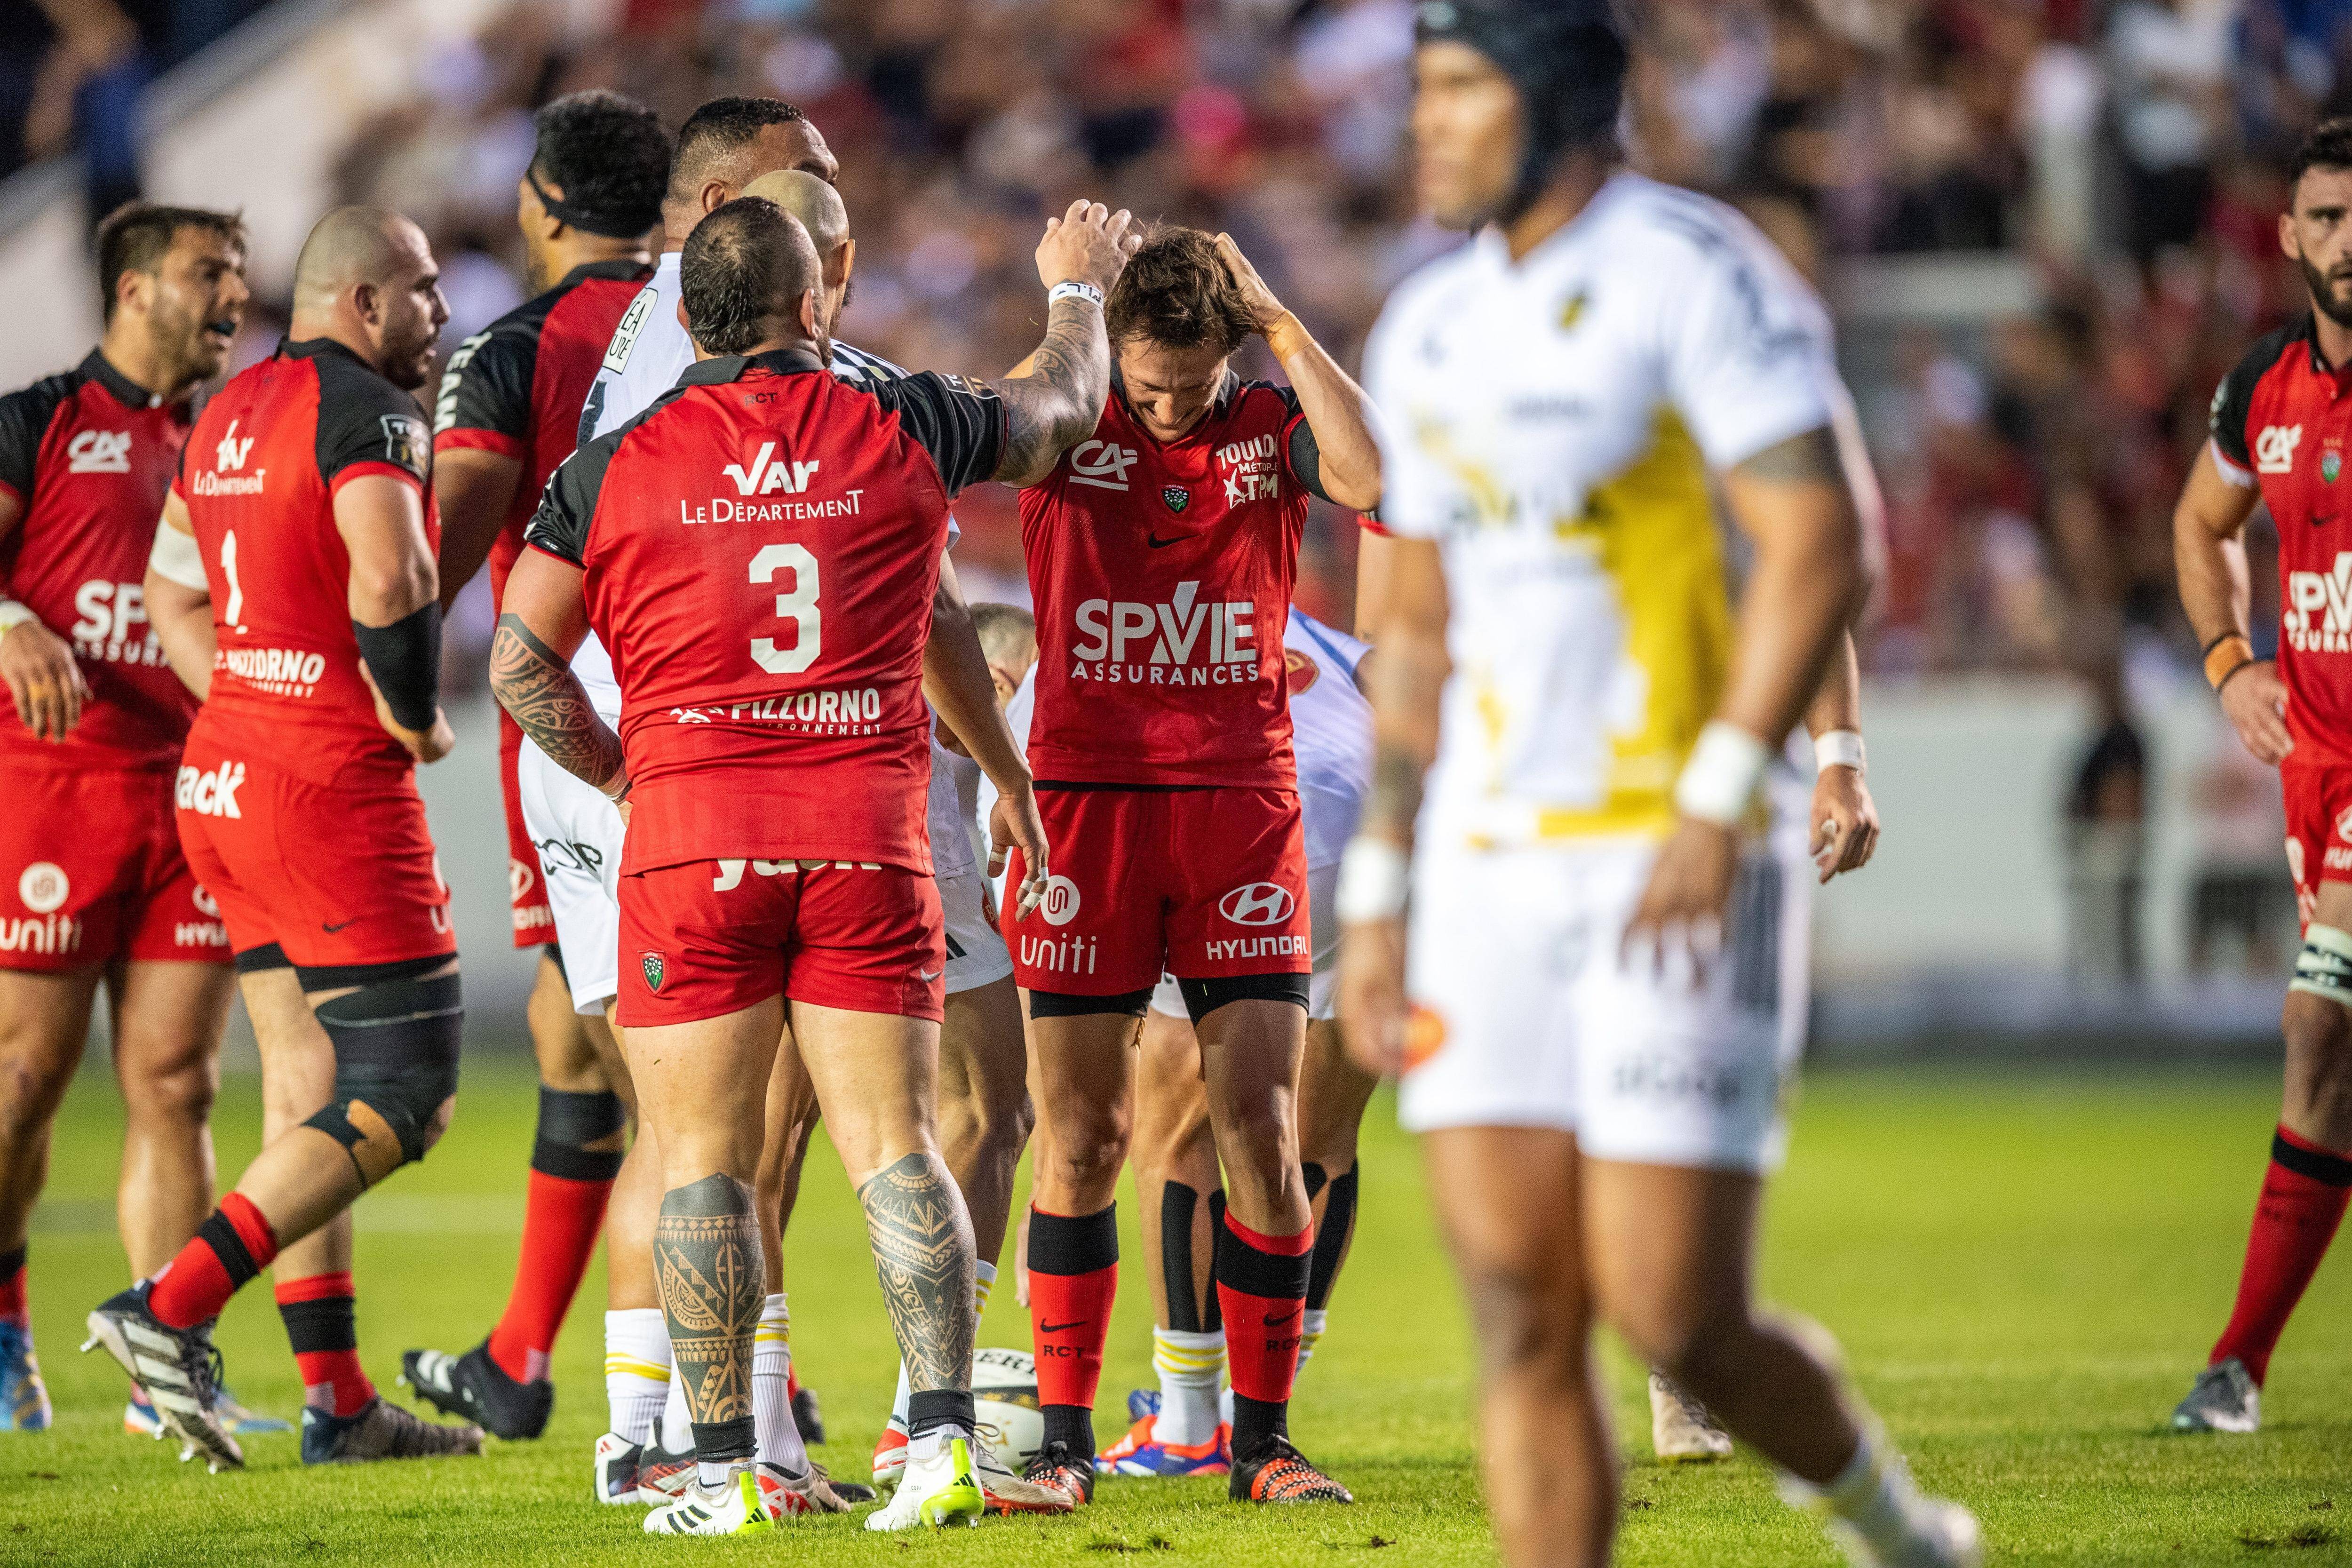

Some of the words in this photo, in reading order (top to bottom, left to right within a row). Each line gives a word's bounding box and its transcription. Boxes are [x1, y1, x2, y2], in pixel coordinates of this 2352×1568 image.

[745, 392, 778, 407] RCT
[221, 529, 248, 634] 1
[749, 543, 821, 674] 3
[1073, 581, 1256, 665] SPVIE
[1071, 661, 1259, 686] ASSURANCES
[1020, 932, 1097, 974] uniti
[1206, 934, 1308, 960] HYUNDAI
[1043, 1345, 1084, 1359] RCT
